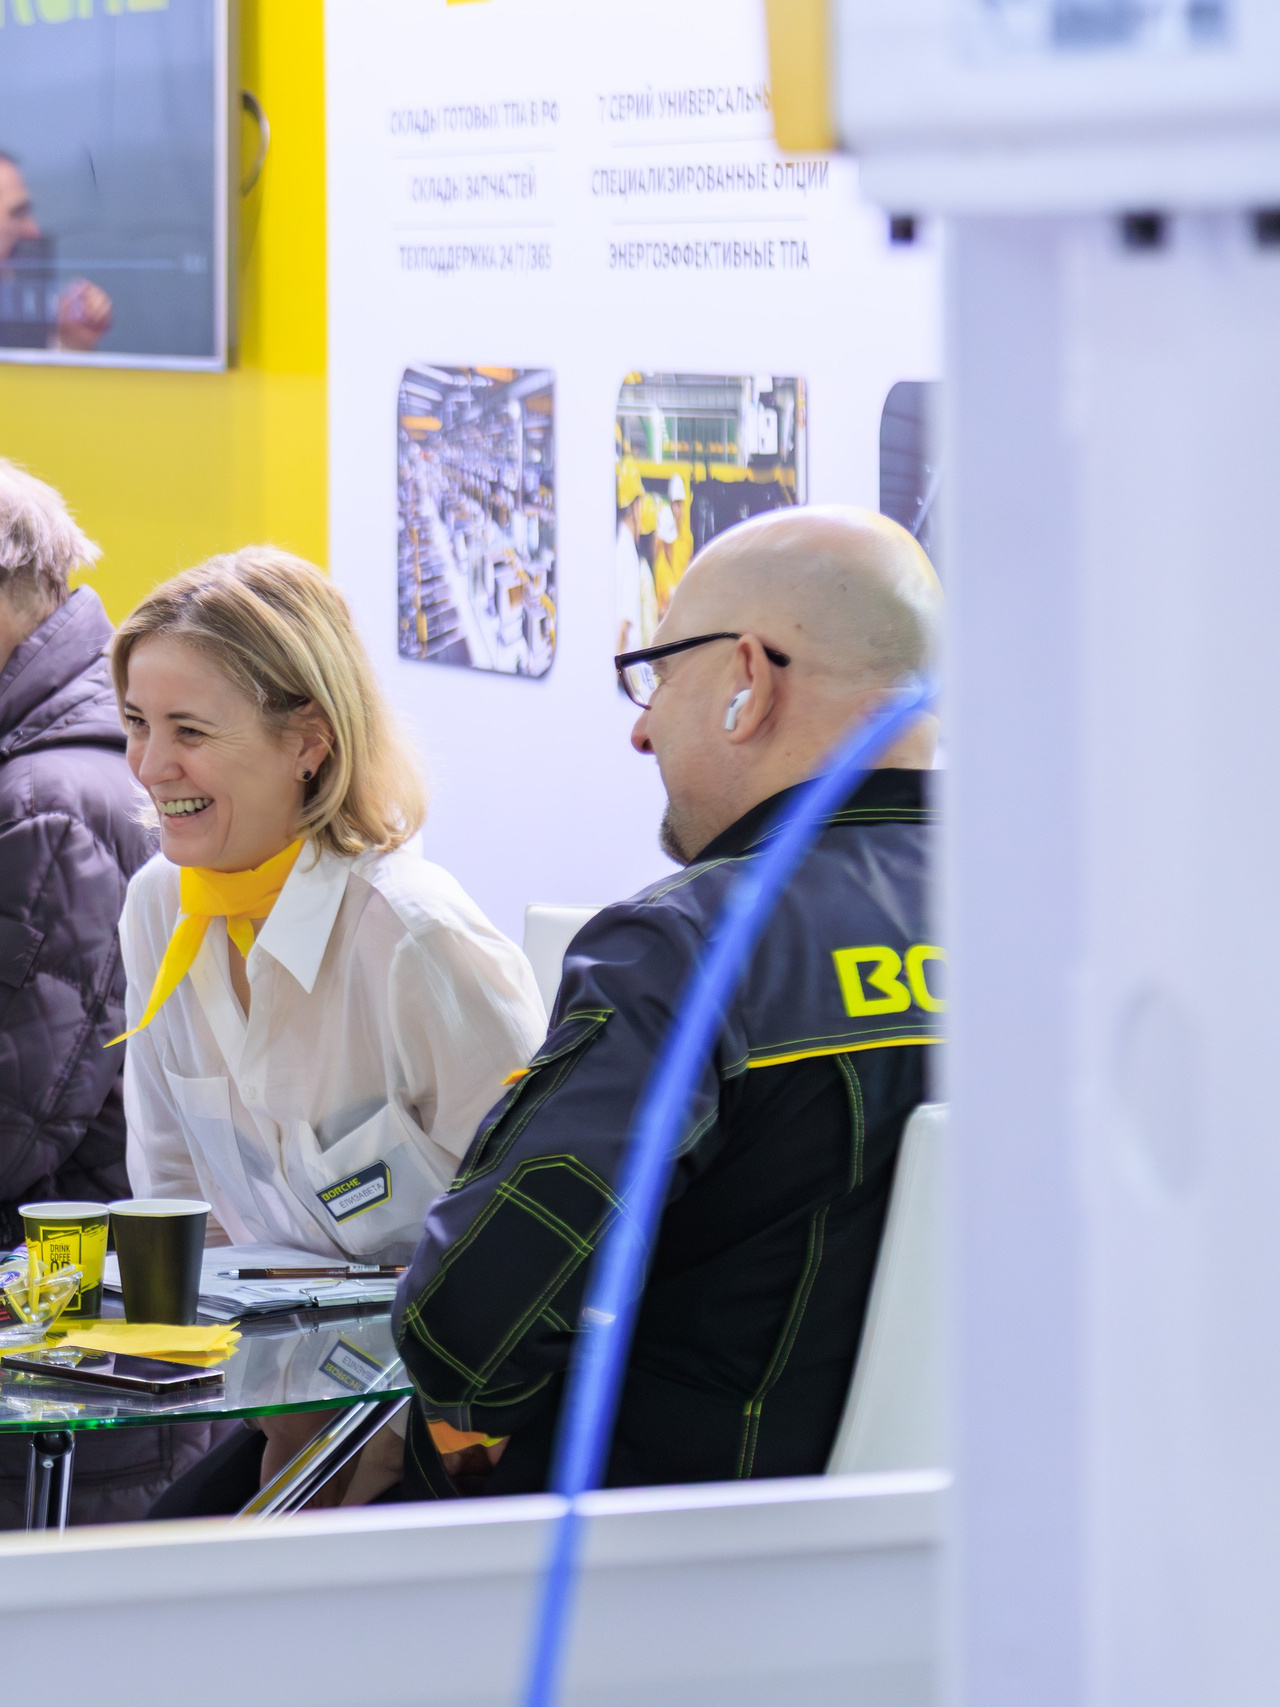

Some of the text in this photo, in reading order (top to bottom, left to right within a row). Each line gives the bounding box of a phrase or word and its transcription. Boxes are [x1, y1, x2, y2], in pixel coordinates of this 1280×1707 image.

[390, 98, 560, 140] СКЛАДЫ ГОТОВЫХ ТПА В РФ
[610, 84, 656, 121] СЕРИЙ
[412, 164, 537, 207] СКЛАДЫ ЗАПЧАСТЕЙ
[591, 161, 830, 203] СПЕЦИАЛИЗИРОВАННЫЕ ОПЦИИ
[399, 241, 552, 278] ТЕХПОДДЕРЖКА 24/7/365
[609, 240, 810, 270] ЭНЕРГОЭФФЕКТИВНЫЕ ТПА
[321, 1177, 361, 1202] BORCHE
[339, 1183, 384, 1209] ЕЛИЗАВЕТА
[50, 1244, 70, 1253] DRINK
[50, 1253, 70, 1261] COFFE
